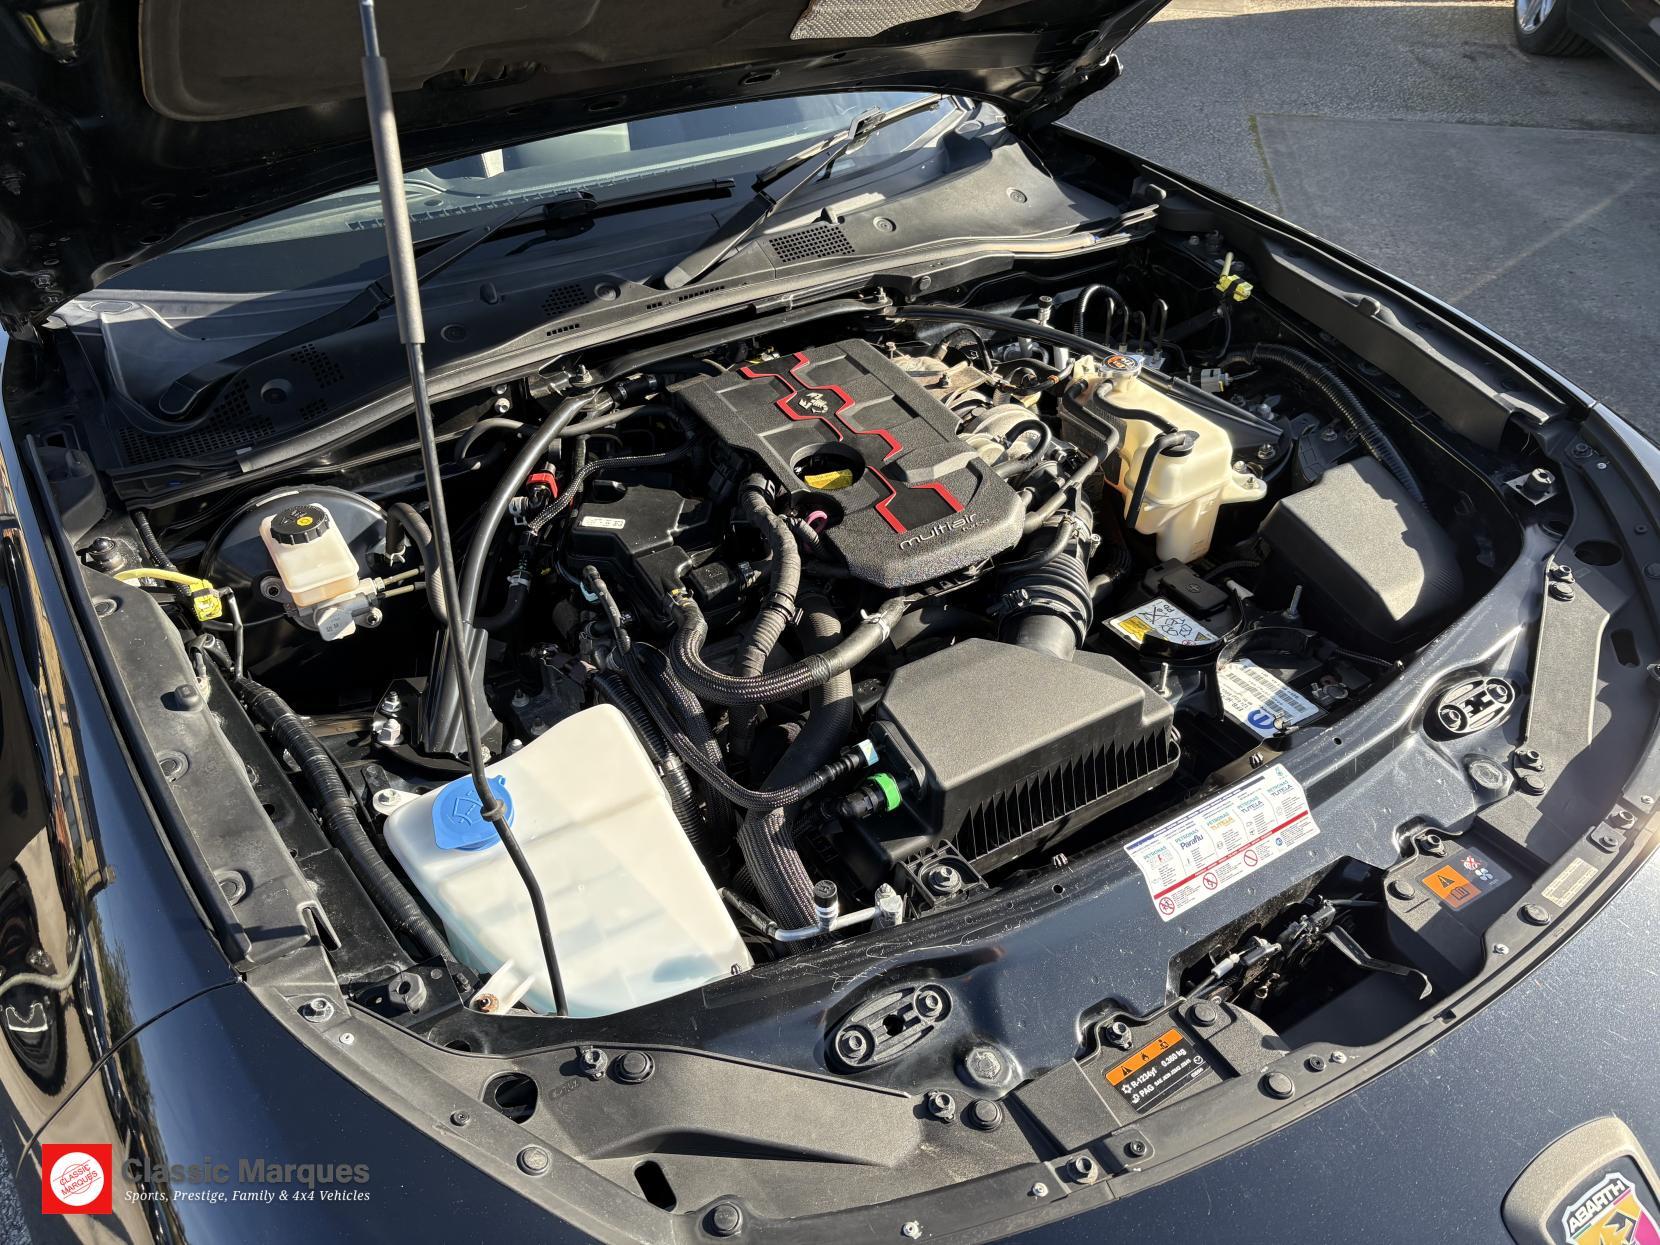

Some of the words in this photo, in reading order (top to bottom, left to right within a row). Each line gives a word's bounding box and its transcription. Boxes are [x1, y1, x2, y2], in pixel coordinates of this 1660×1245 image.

[900, 514, 976, 549] multiair
[1180, 833, 1204, 850] Paraflu
[1130, 1067, 1157, 1089] R-1234yf
[1176, 1048, 1187, 1057] kg
[1139, 1084, 1155, 1098] PAG
[1568, 1179, 1626, 1234] ABARTH
